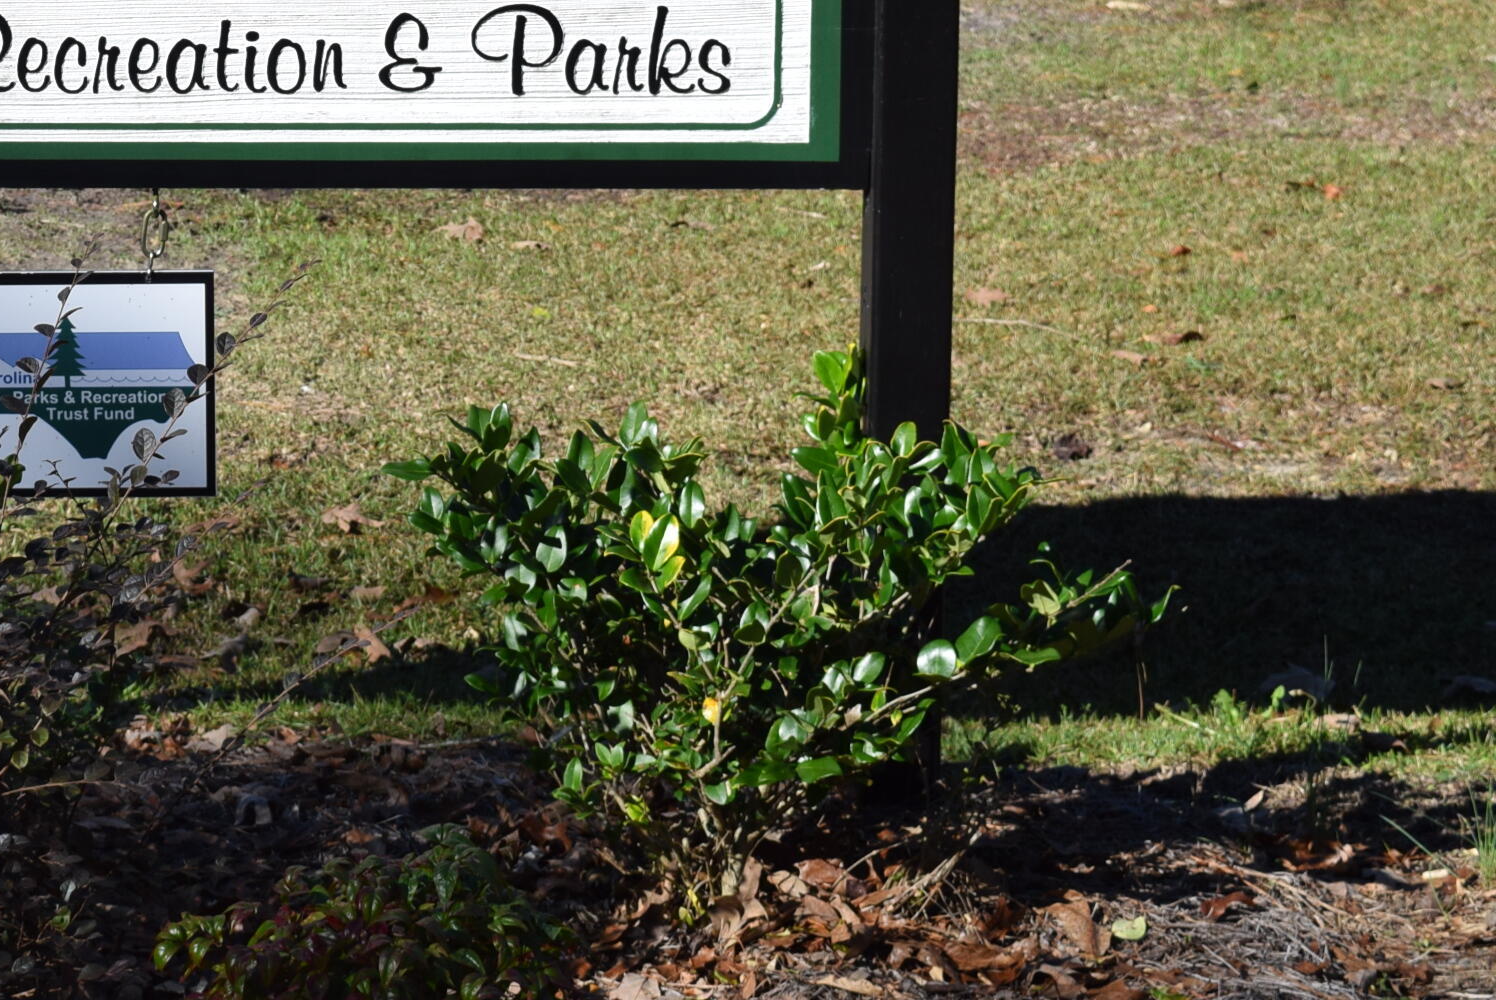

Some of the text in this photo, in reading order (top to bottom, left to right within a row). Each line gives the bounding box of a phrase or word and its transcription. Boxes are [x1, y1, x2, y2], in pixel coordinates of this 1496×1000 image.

[378, 12, 442, 93] &
[471, 3, 733, 97] Parks
[13, 391, 58, 404] Parks
[63, 391, 75, 404] &
[47, 406, 135, 421] Trust Fund
